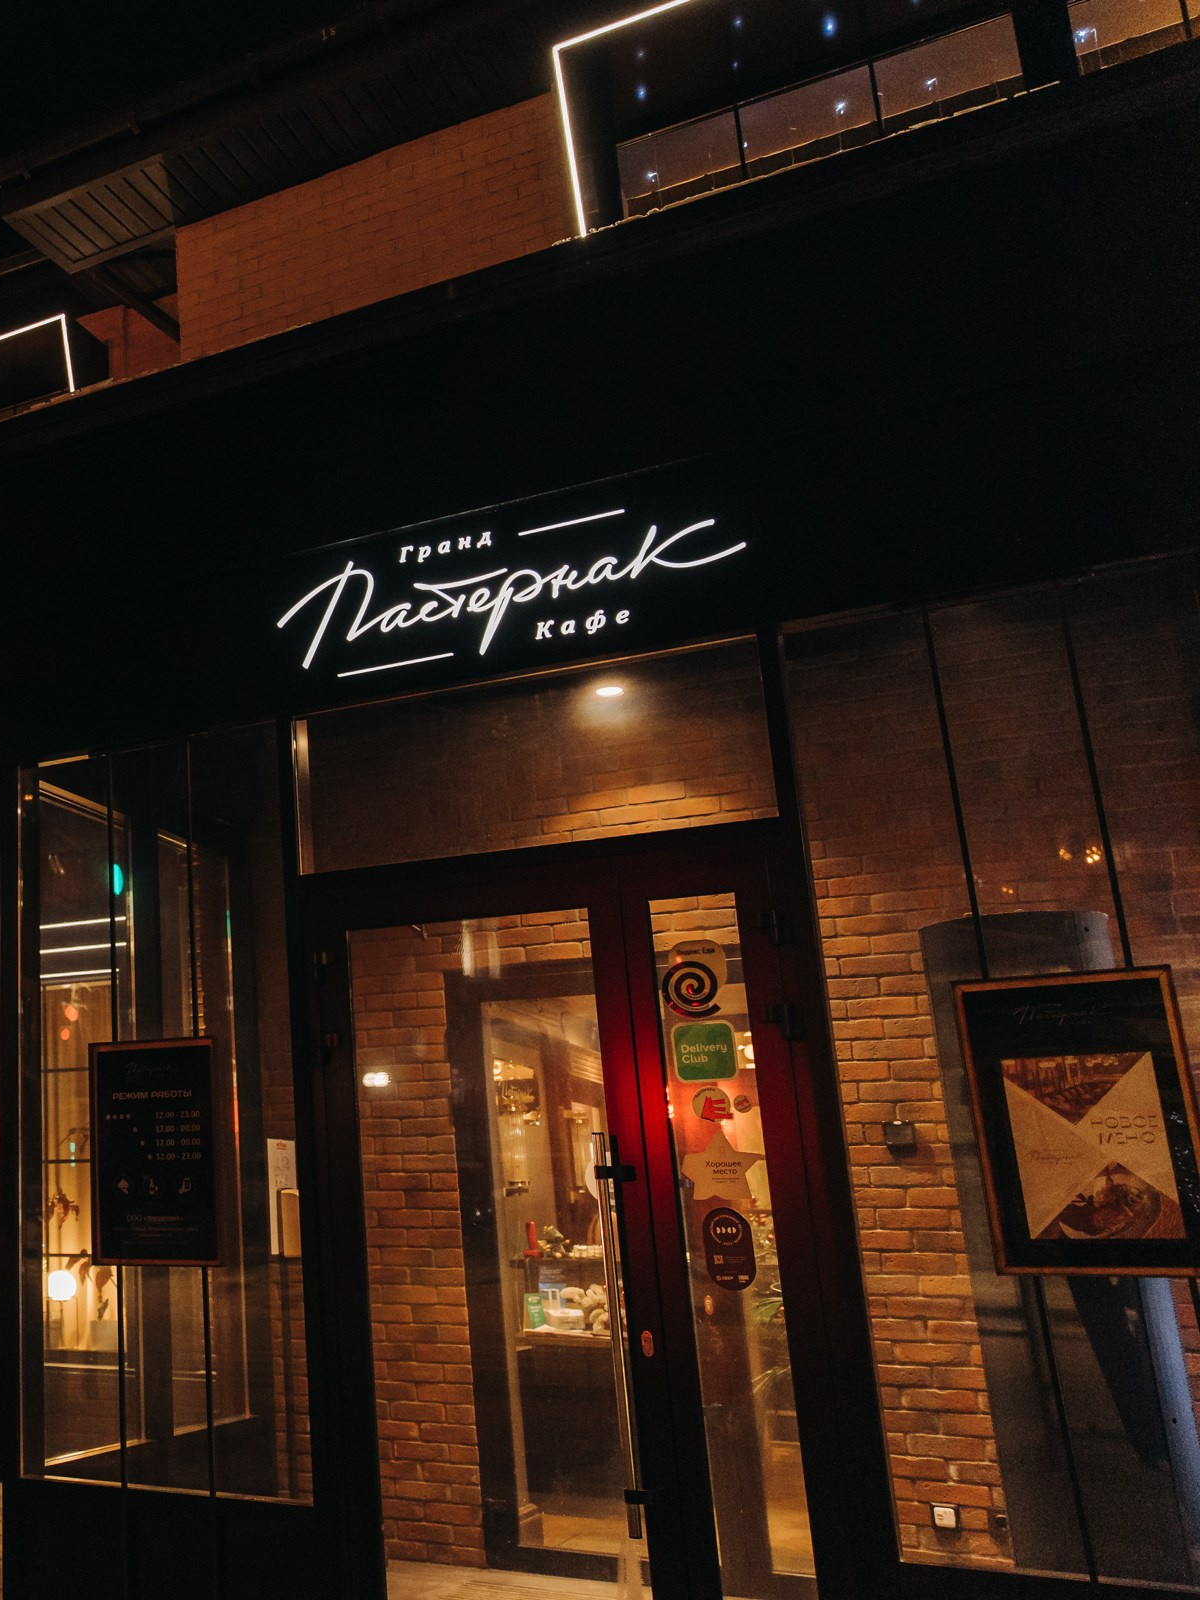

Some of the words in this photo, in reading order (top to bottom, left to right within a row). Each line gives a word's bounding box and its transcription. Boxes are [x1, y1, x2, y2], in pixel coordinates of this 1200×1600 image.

[398, 530, 493, 564] Гранд
[276, 518, 747, 670] Пастернак
[534, 609, 630, 641] Кафе
[680, 1043, 728, 1053] Delivery
[681, 1054, 709, 1064] Club
[112, 1090, 149, 1100] РЕЖИМ
[151, 1089, 192, 1099] РАБОТЫ
[155, 1111, 175, 1119] 12.00
[155, 1125, 175, 1133] 12.00
[155, 1138, 176, 1147] 12.00
[156, 1152, 176, 1160] 12.00
[704, 1160, 742, 1169] Хорошее
